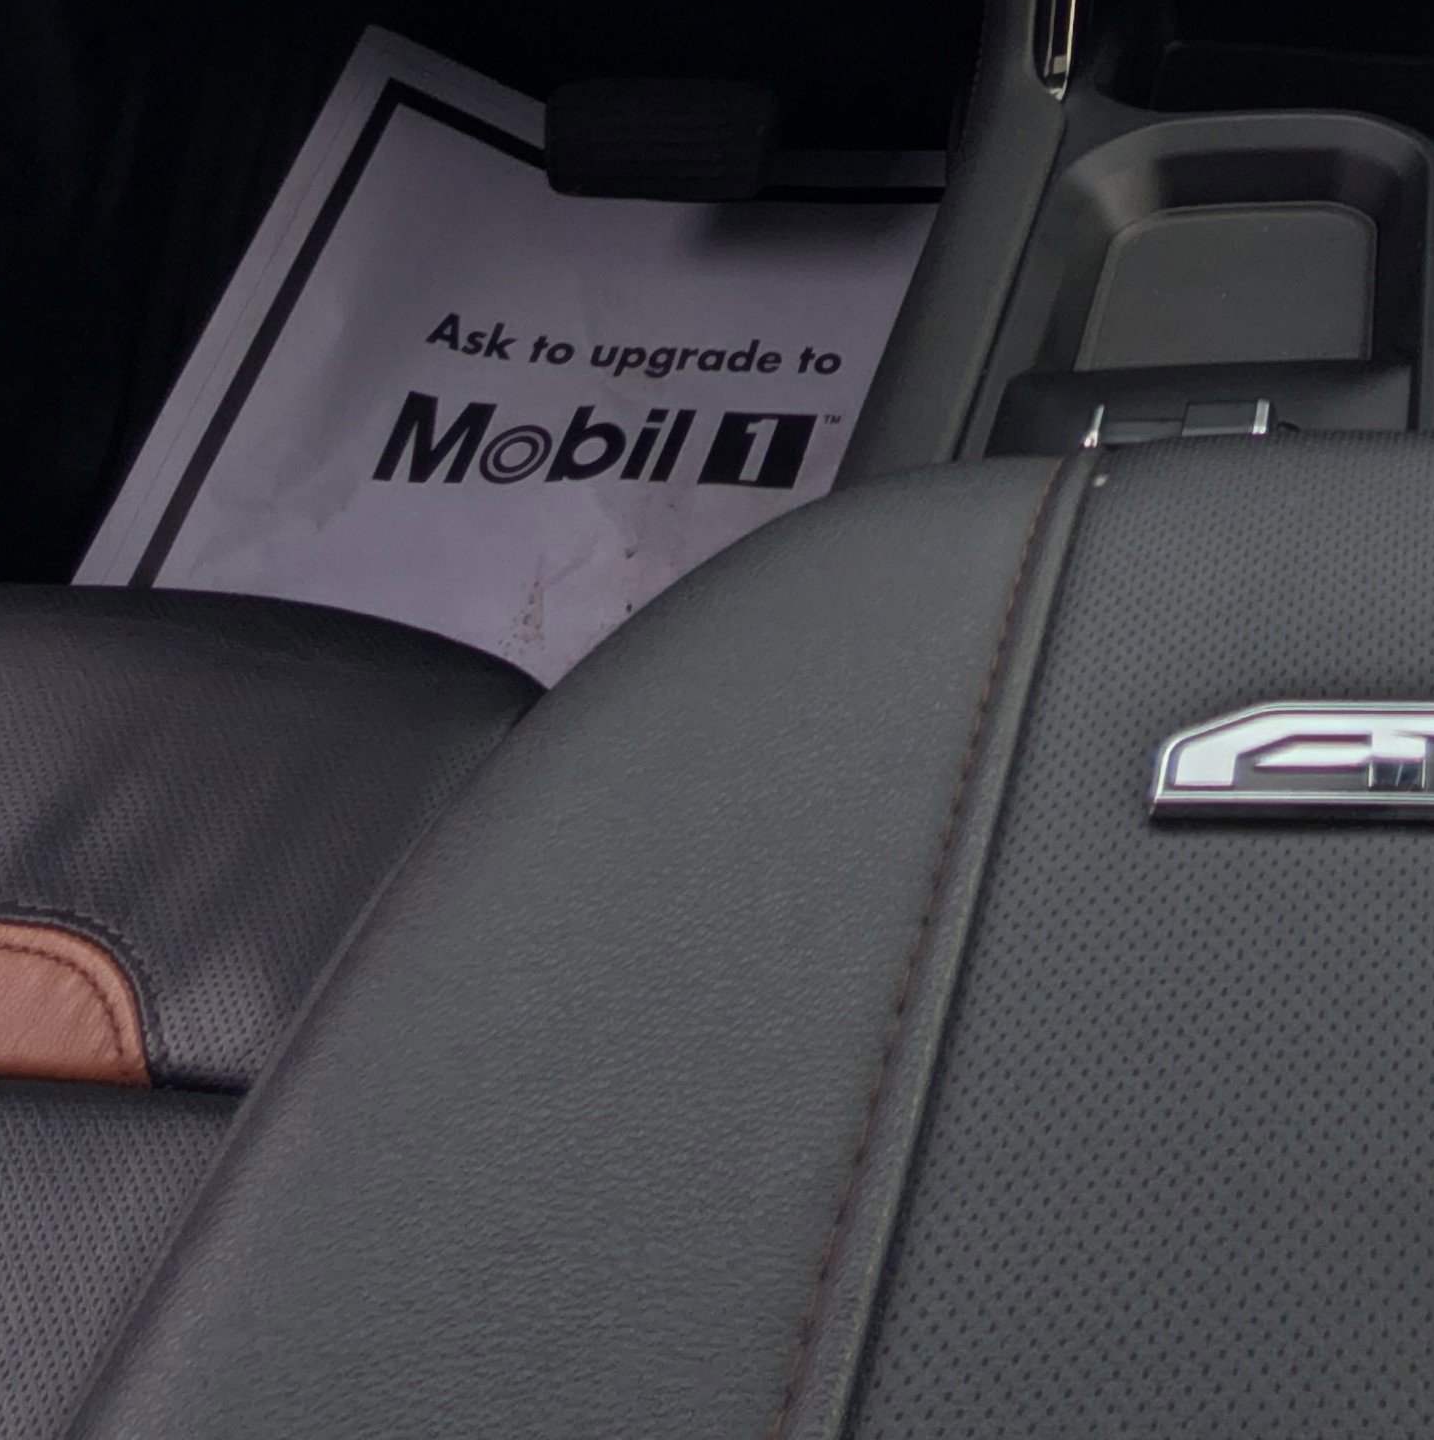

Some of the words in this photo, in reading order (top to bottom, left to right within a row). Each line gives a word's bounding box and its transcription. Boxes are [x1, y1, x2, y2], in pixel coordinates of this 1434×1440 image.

[426, 313, 516, 361] Ask
[529, 335, 574, 364] to
[590, 339, 783, 377] upgrade
[797, 346, 842, 375] to
[372, 391, 697, 485] Mobil
